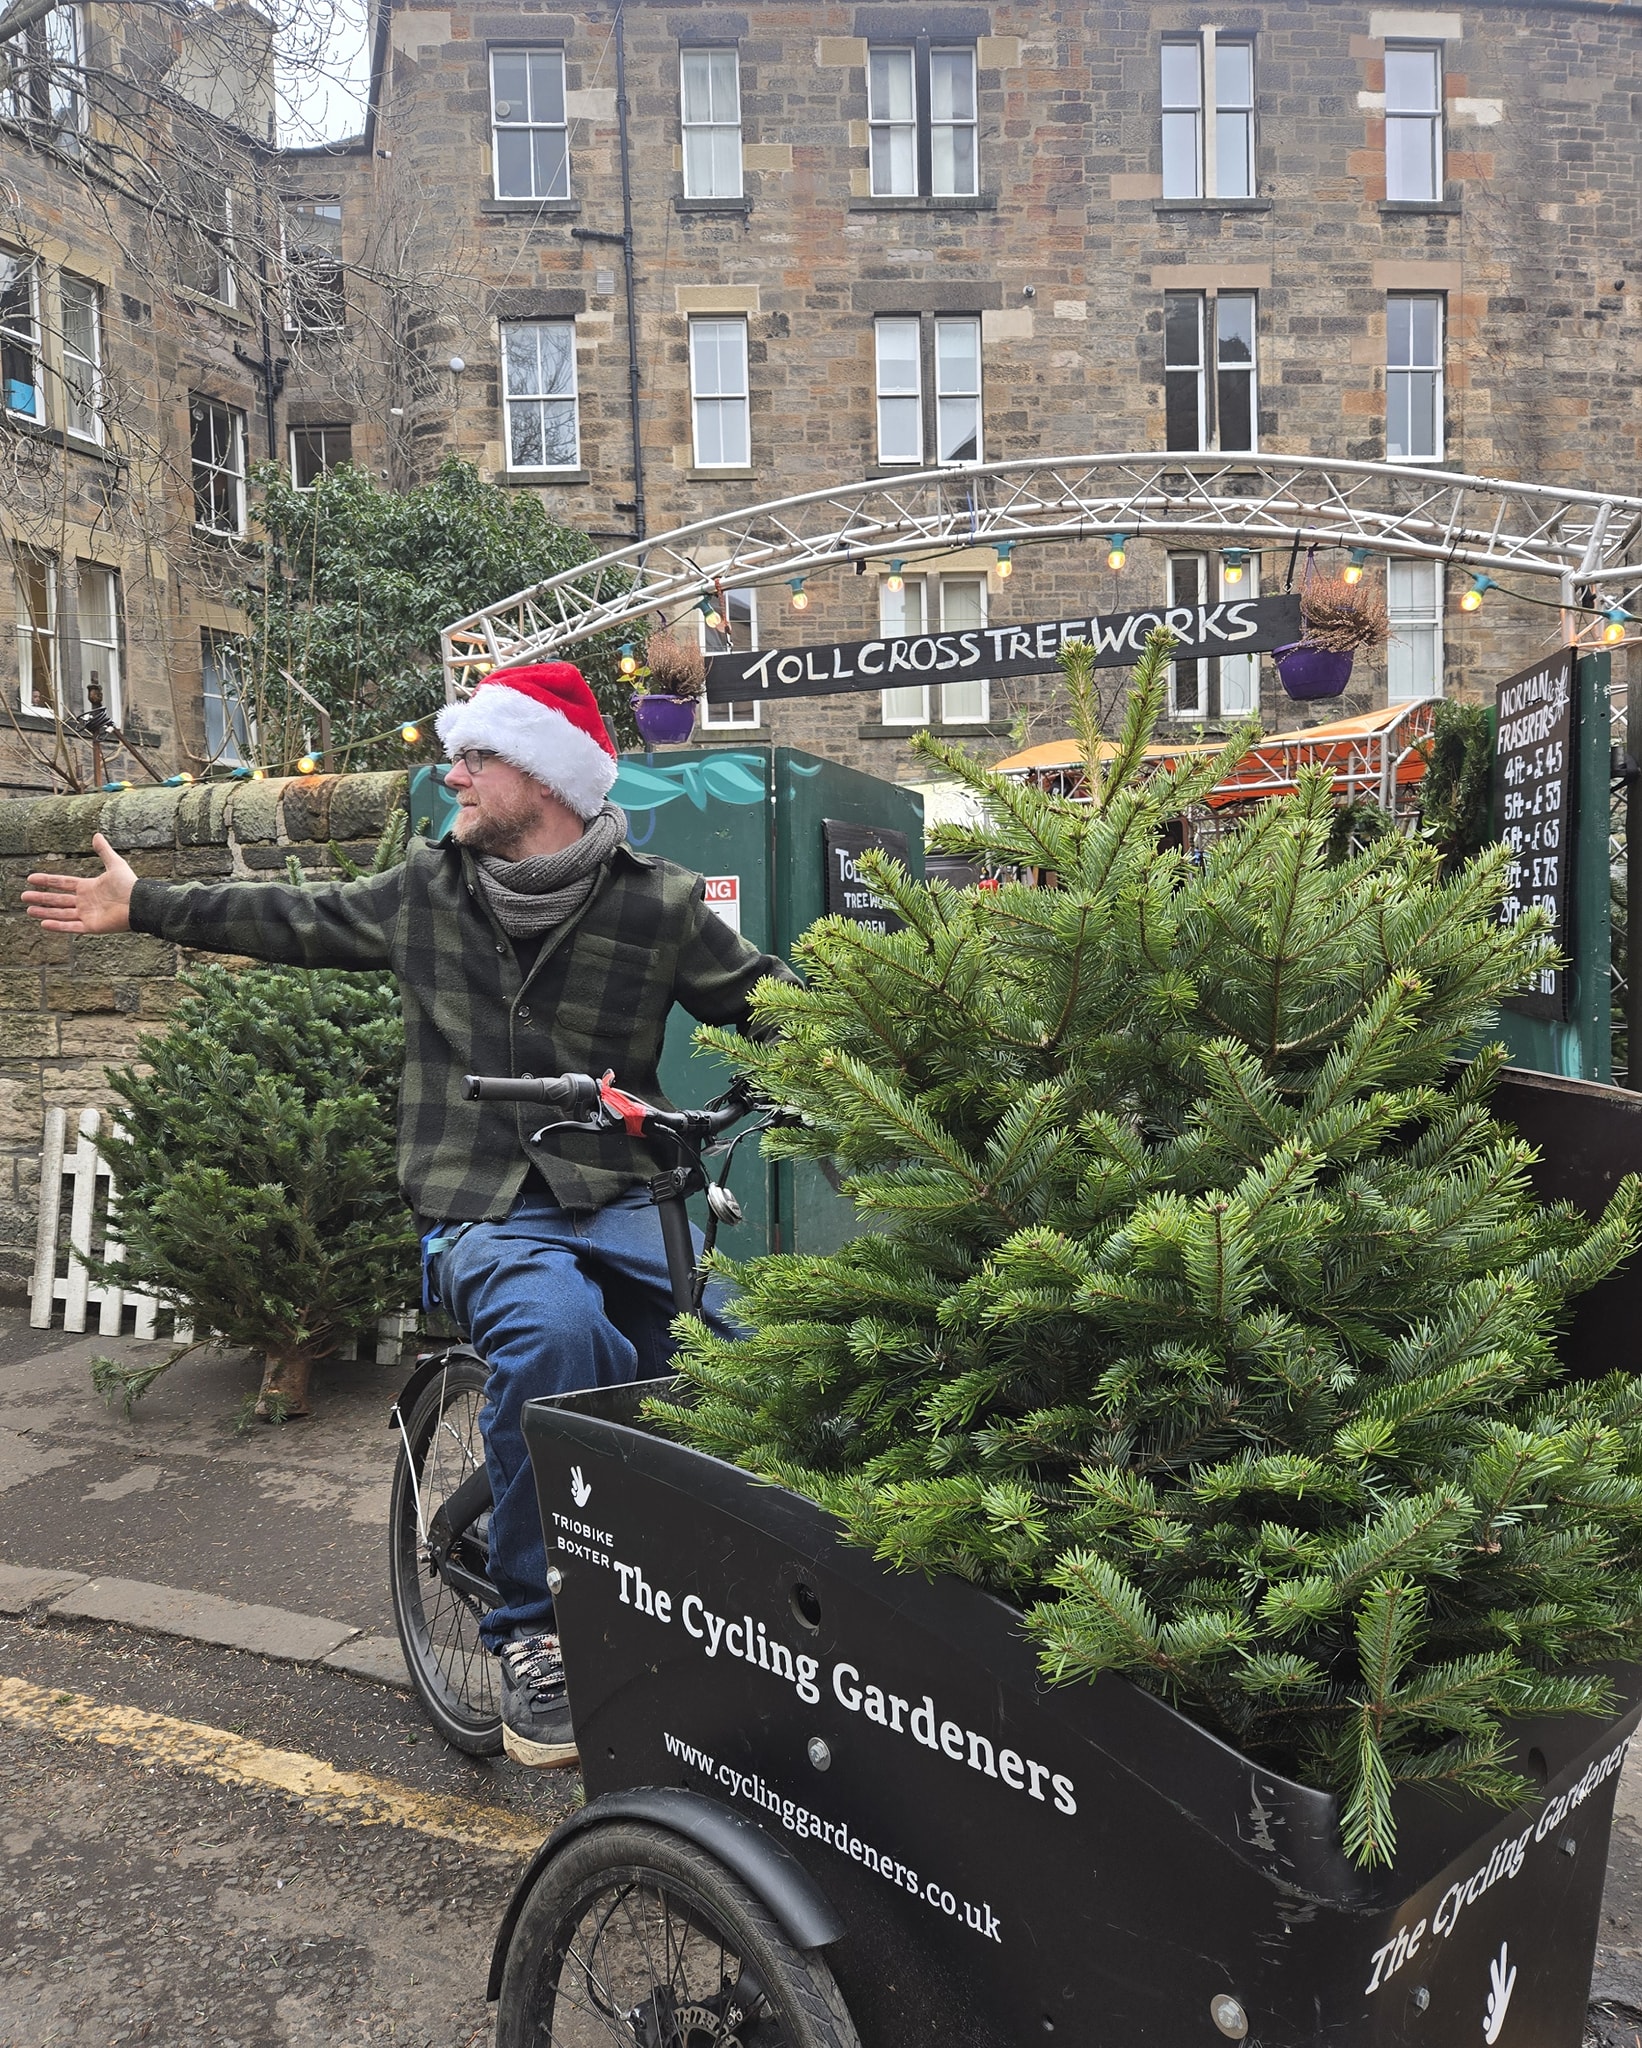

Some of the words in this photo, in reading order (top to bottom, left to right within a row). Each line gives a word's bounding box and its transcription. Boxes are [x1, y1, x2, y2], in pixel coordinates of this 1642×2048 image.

[552, 1512, 614, 1548] TRIOBIKE
[557, 1536, 610, 1569] BOXTER
[613, 1560, 672, 1624] The
[682, 1594, 820, 1705] Cycling
[832, 1662, 1079, 1816] Gardeners
[664, 1731, 1003, 1944] www.cyclinggardeners.co.uk
[1365, 1918, 1427, 1995] The
[1432, 1824, 1534, 1938] Cycling
[1535, 1735, 1631, 1843] Gardener
